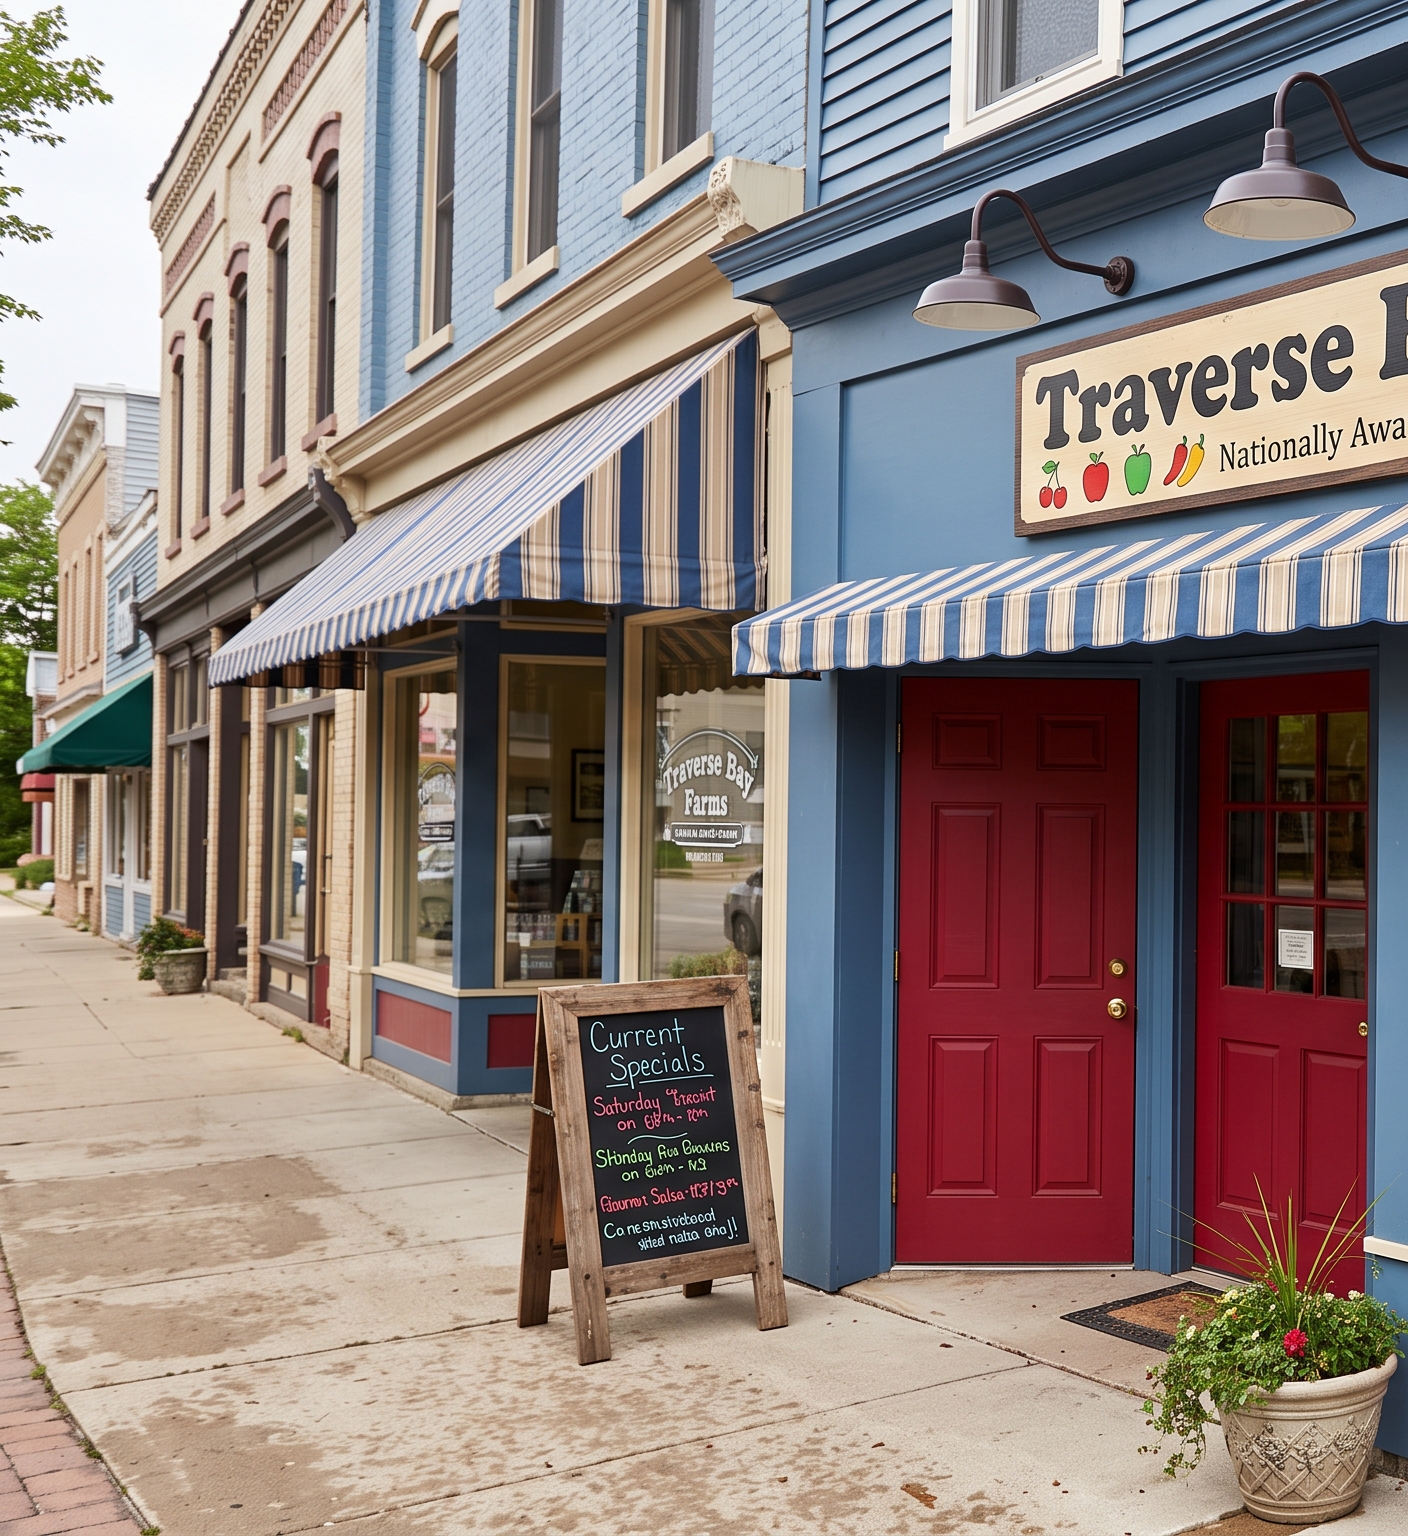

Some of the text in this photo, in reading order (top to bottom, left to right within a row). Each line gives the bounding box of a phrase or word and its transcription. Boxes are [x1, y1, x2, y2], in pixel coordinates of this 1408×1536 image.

[1035, 323, 1355, 450] Traverse
[1219, 422, 1344, 473] Nationally
[662, 750, 755, 800] Traverse Bay
[684, 788, 728, 816] Farms
[590, 1017, 685, 1053] Current
[609, 1045, 706, 1090] Specials
[593, 1091, 662, 1117] Saturday
[617, 1119, 637, 1131] on
[621, 1170, 640, 1182] on
